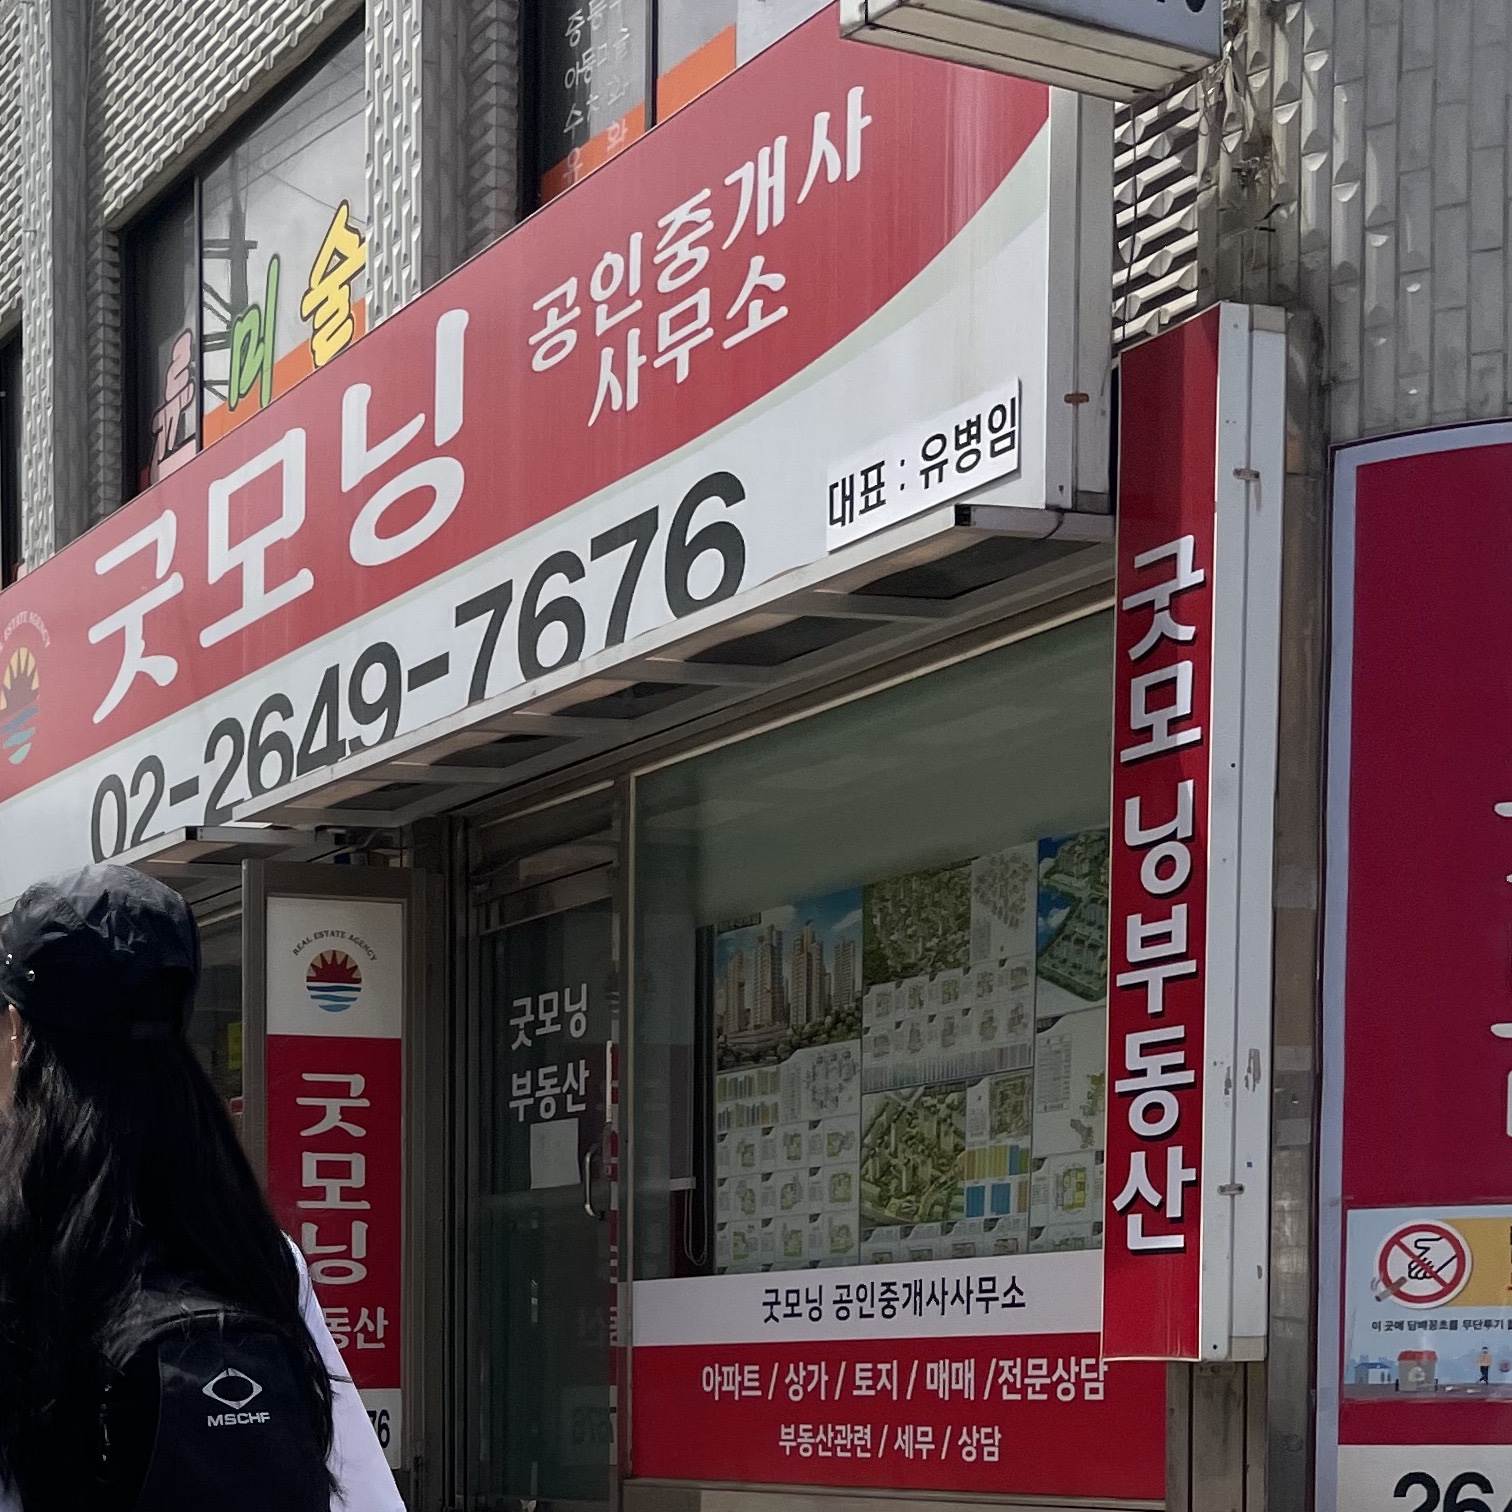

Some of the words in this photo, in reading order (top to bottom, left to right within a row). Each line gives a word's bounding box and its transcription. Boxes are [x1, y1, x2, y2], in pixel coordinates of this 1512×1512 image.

[528, 86, 872, 374] 공인중개사
[587, 256, 789, 428] 사무소
[828, 459, 886, 529] 대표
[918, 397, 1019, 491] 유병임
[88, 307, 470, 725] 굿모닝
[91, 470, 746, 864] 02-2649-7676
[1112, 534, 1205, 1250] 굿모닝부동산
[292, 937, 314, 956] REAL
[313, 929, 347, 940] ESTATE
[348, 934, 378, 961] AGENCY
[509, 983, 588, 1051] 굿모닝
[509, 1060, 590, 1122] 부동산
[296, 1073, 370, 1286] 굿모닝
[324, 1306, 389, 1350] 동산
[761, 1284, 824, 1324] 굿모닝
[832, 1275, 1027, 1320] 공인중개사사무소
[1371, 1320, 1382, 1332] 이
[1384, 1320, 1405, 1332] 곳에
[1407, 1319, 1458, 1332] 담배꽁초를
[1462, 1319, 1505, 1331] 무단투기
[701, 1362, 763, 1401] 아파트
[784, 1361, 829, 1402] 상가
[852, 1360, 899, 1401] 토지
[925, 1358, 976, 1401] 매매
[207, 1411, 271, 1426] MSCHF
[778, 1423, 872, 1459] 부동산관련
[894, 1424, 936, 1460] 세무
[958, 1425, 1002, 1462] 상담
